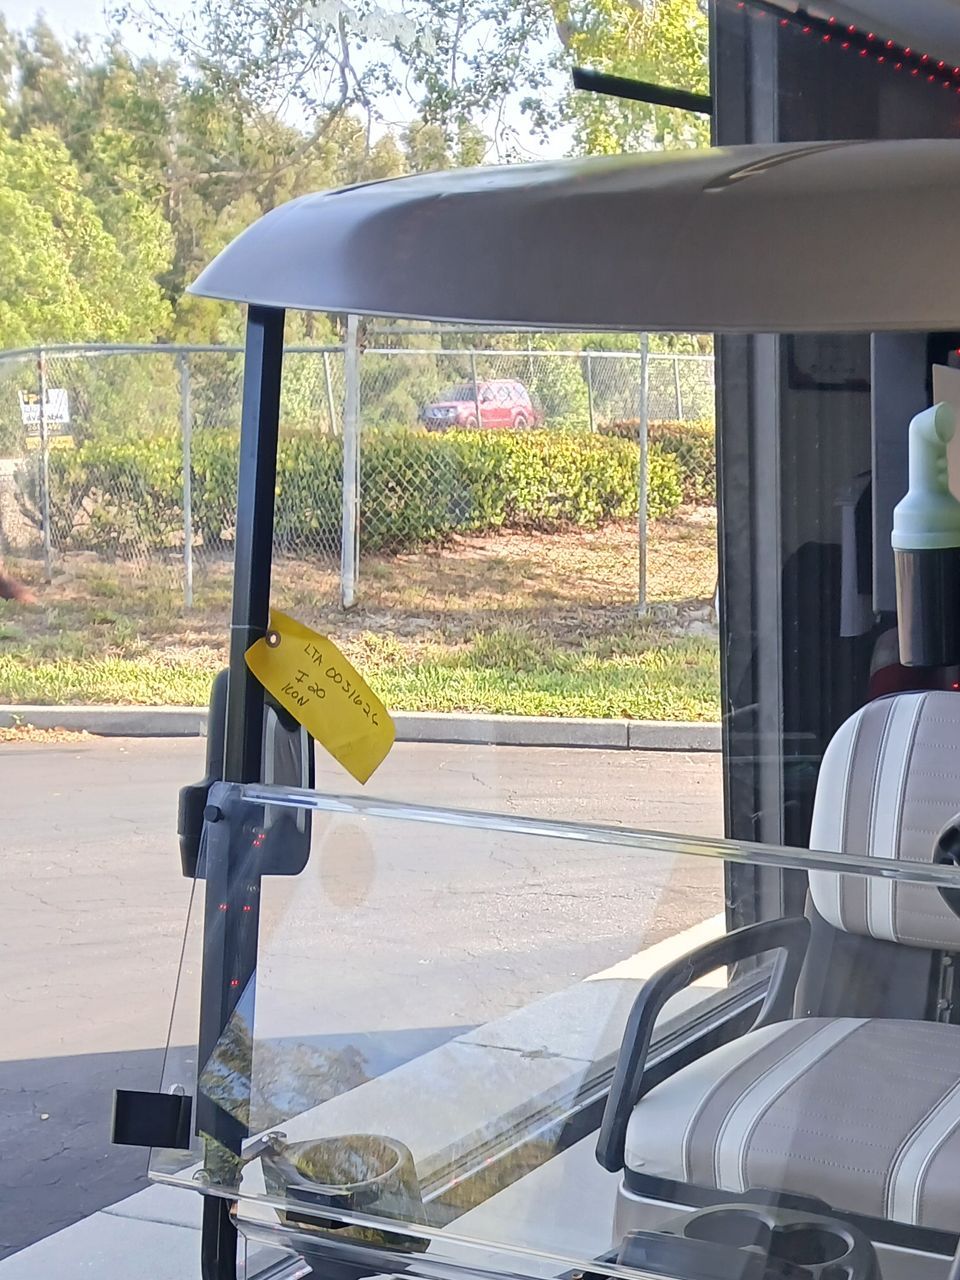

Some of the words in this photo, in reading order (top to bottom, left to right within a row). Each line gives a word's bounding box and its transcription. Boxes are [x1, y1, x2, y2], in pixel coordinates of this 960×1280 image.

[303, 643, 323, 666] LTA
[281, 683, 310, 707] ICON
[307, 682, 326, 699] 20
